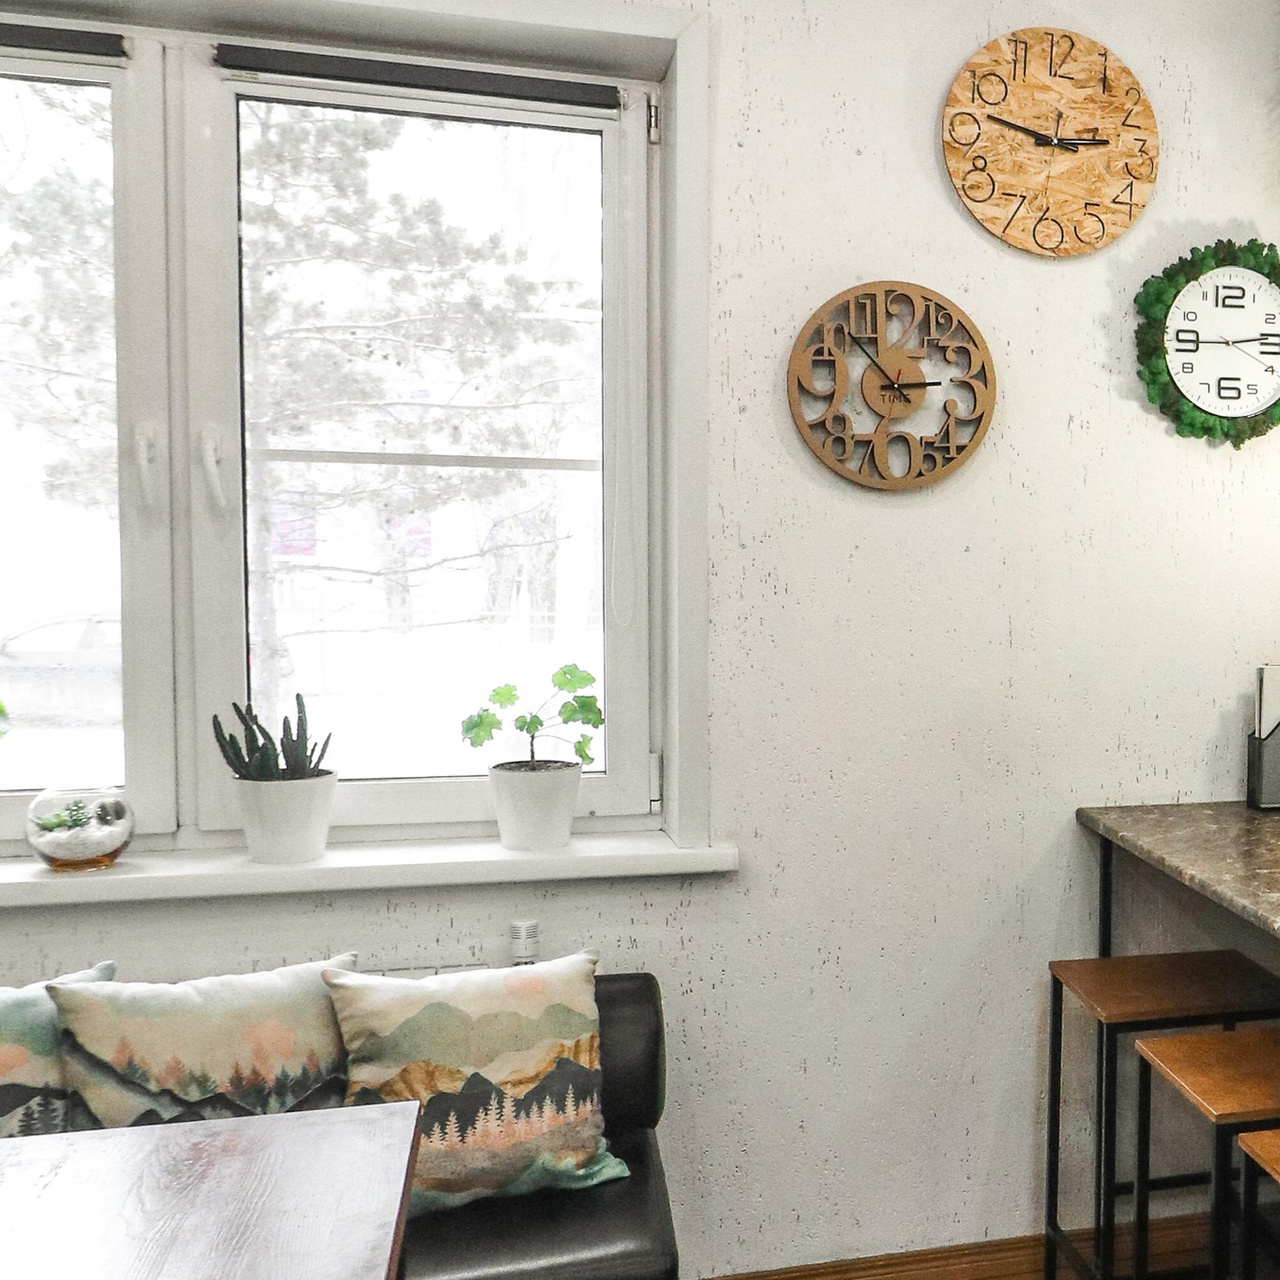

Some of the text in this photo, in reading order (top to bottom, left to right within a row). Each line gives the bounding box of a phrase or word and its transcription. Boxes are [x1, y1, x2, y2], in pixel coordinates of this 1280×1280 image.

[1007, 38, 1029, 83] 11
[1044, 31, 1075, 80] 12
[967, 70, 1008, 106] 10
[1121, 87, 1141, 129] 2
[949, 111, 981, 158] 9
[962, 155, 996, 203] 8
[1125, 138, 1154, 180] 3
[1001, 192, 1027, 234] 7
[1111, 180, 1145, 221] 4
[1033, 206, 1064, 251] 6
[1074, 202, 1105, 244] 5
[1182, 311, 1198, 322] 10
[1215, 285, 1245, 309] 12
[876, 290, 927, 358] 12
[1264, 313, 1277, 325] 2
[1176, 329, 1199, 352] 9
[944, 342, 986, 421] 3
[1182, 362, 1194, 373] 8
[1199, 382, 1210, 393] 7
[1218, 377, 1241, 400] 6
[1264, 365, 1276, 376] 4
[1246, 383, 1258, 395] 5
[823, 411, 855, 460] 8
